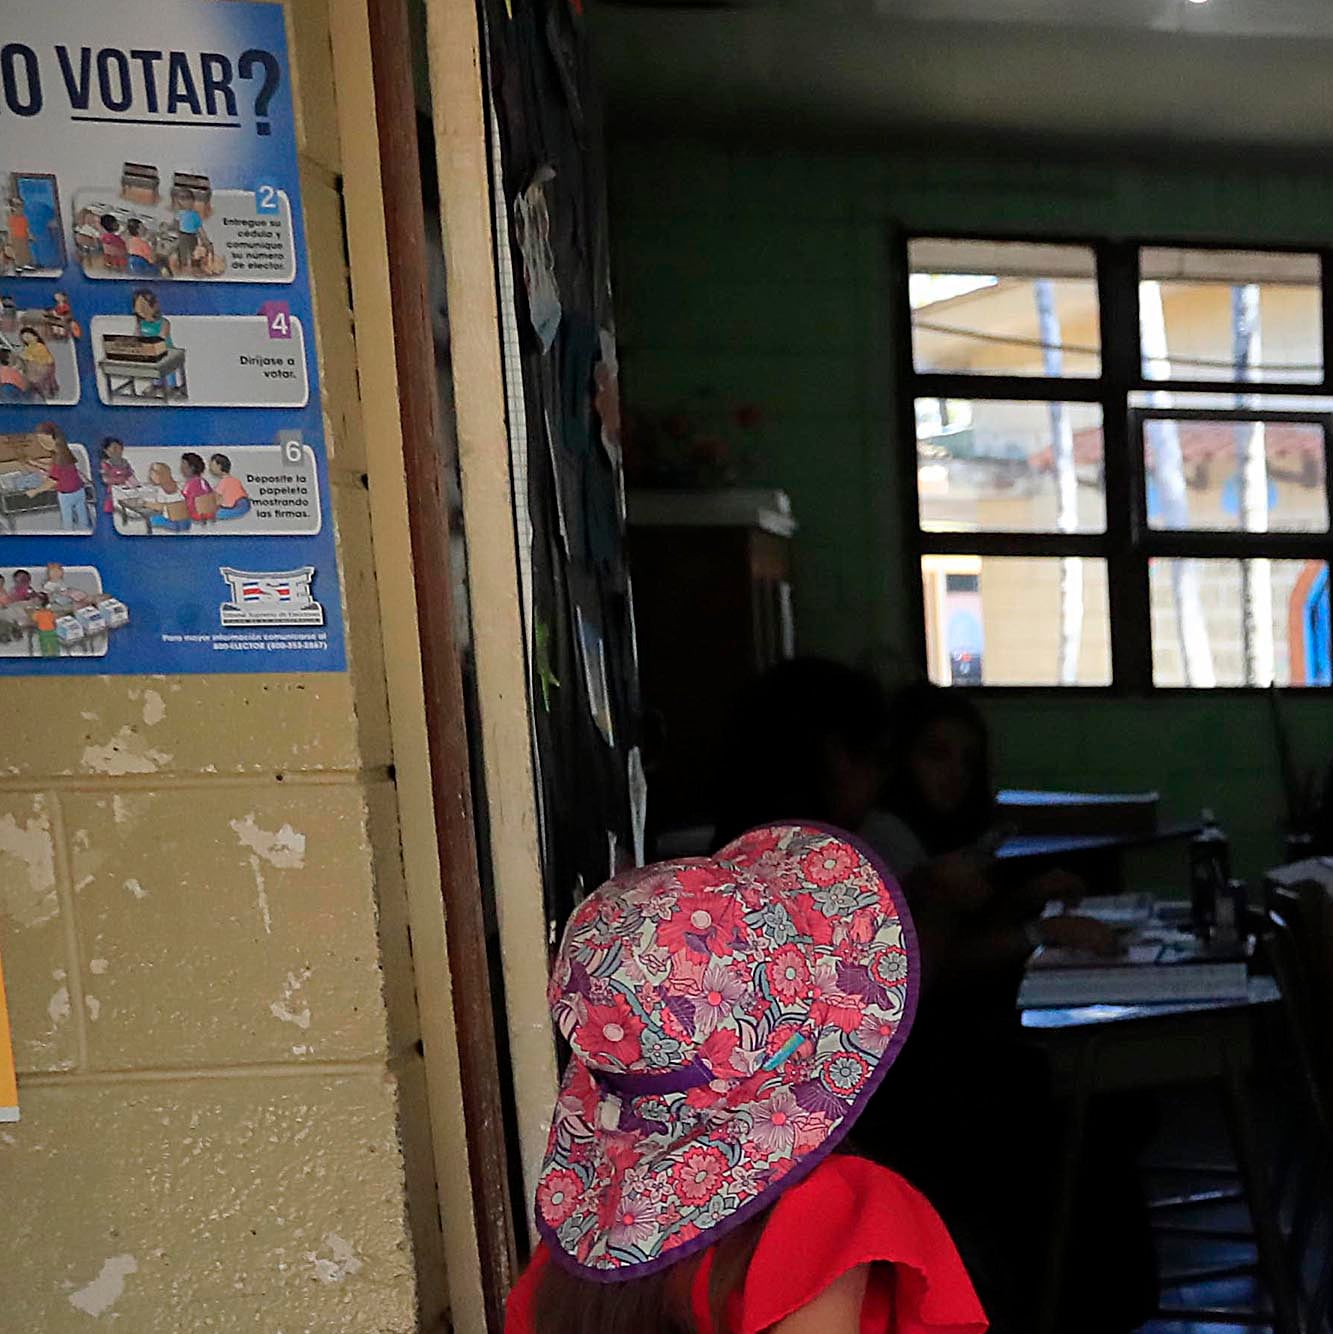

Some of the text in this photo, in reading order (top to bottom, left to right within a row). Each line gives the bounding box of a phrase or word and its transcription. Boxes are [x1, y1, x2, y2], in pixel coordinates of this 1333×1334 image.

[54, 45, 281, 136] VOTAR?
[260, 185, 277, 208] 2
[272, 312, 288, 335] 4
[287, 358, 295, 366] a
[264, 369, 297, 379] votar.
[286, 440, 301, 462] 6
[247, 474, 306, 483] Deposite la
[260, 487, 308, 496] papeleta
[252, 499, 309, 507] mostrando
[257, 510, 310, 519] las firmas.
